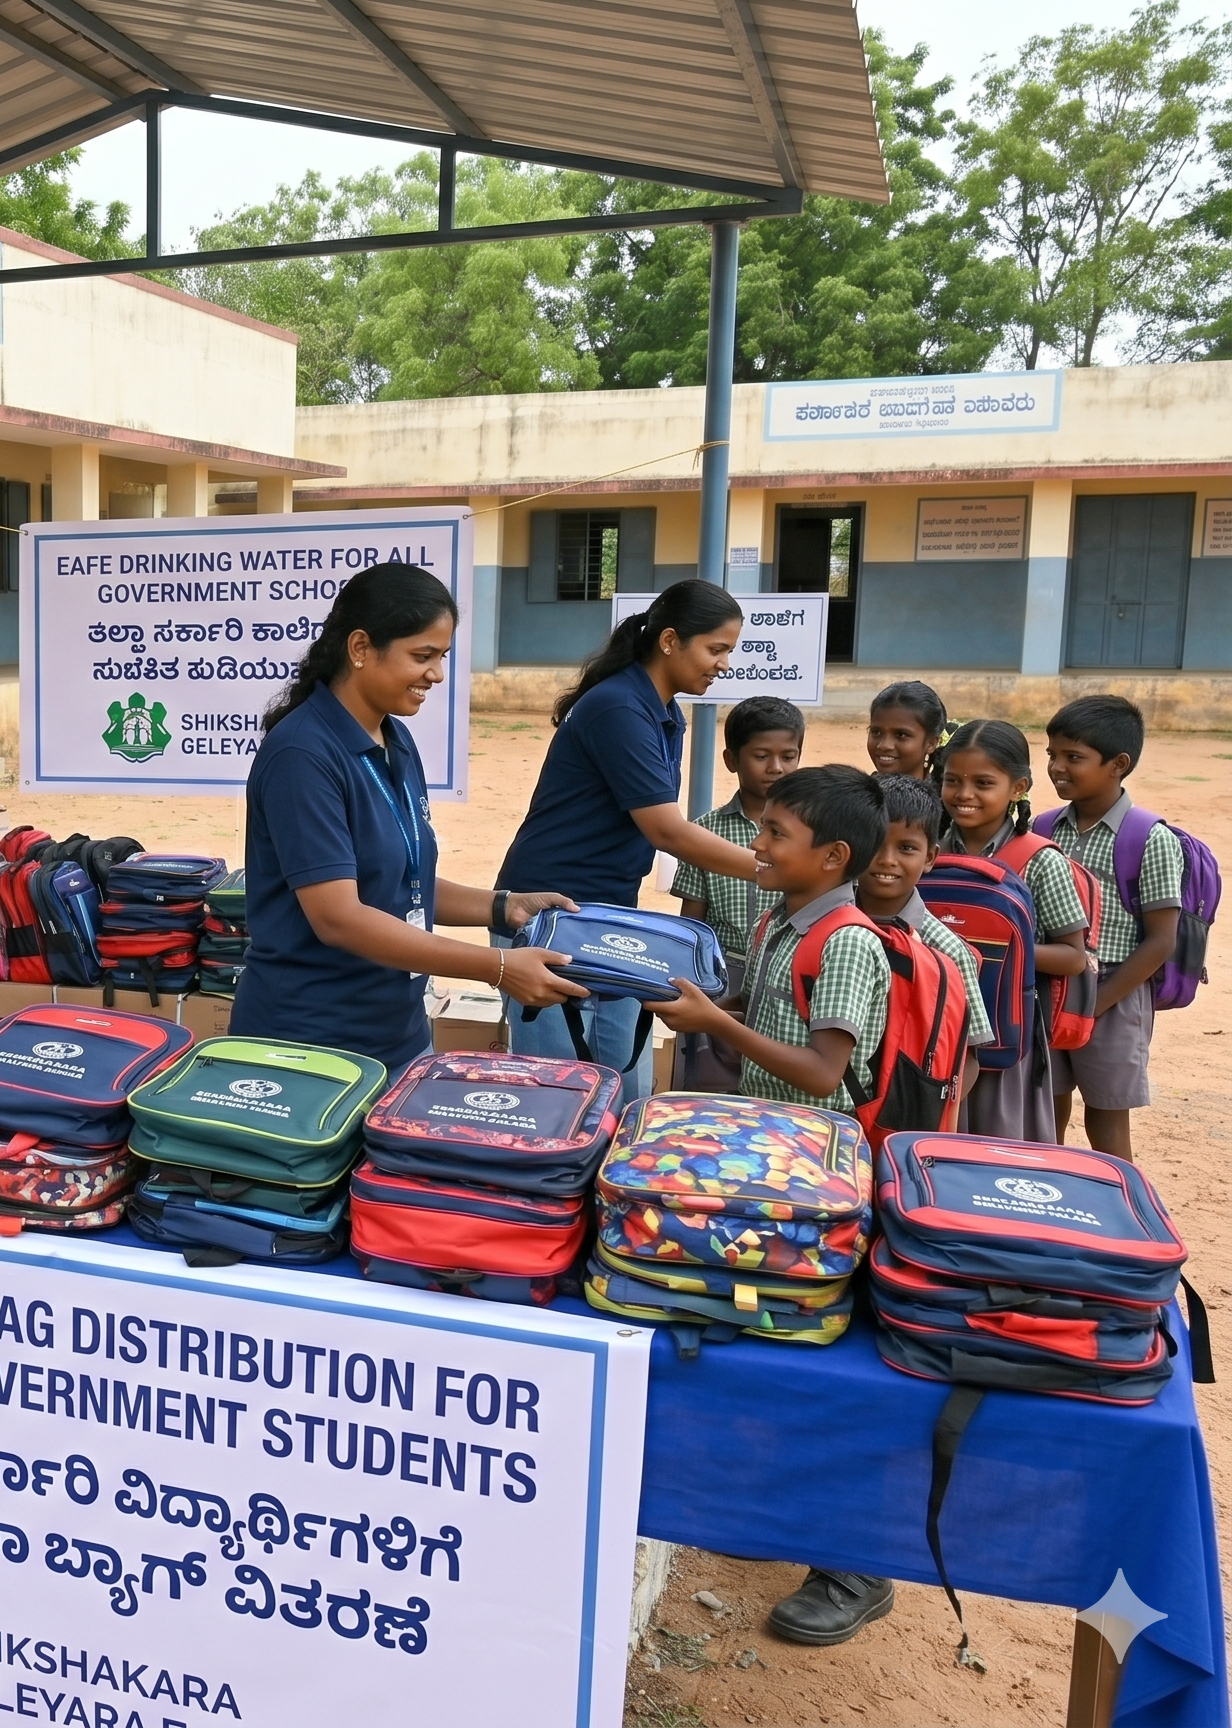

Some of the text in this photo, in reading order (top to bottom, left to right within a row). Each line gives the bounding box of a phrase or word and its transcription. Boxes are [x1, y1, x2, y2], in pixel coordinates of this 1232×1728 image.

[57, 546, 434, 576] EAFE DRINKING WATER FOR ALL
[97, 580, 263, 604] GOVERNMENT
[181, 713, 257, 731] SHIKSH
[181, 737, 258, 755] GELEYA
[72, 1306, 415, 1412] DISTRIBUTION
[435, 1366, 540, 1434] FOR
[262, 1408, 538, 1504] STUDENTS
[114, 1468, 463, 1582] ವಿದ್ಯಾರ್ಥಿಗಳಿಗೆ
[44, 1532, 207, 1617] ಬ್ಯಾಗ್
[224, 1564, 430, 1655] ವಿತರಣೆ
